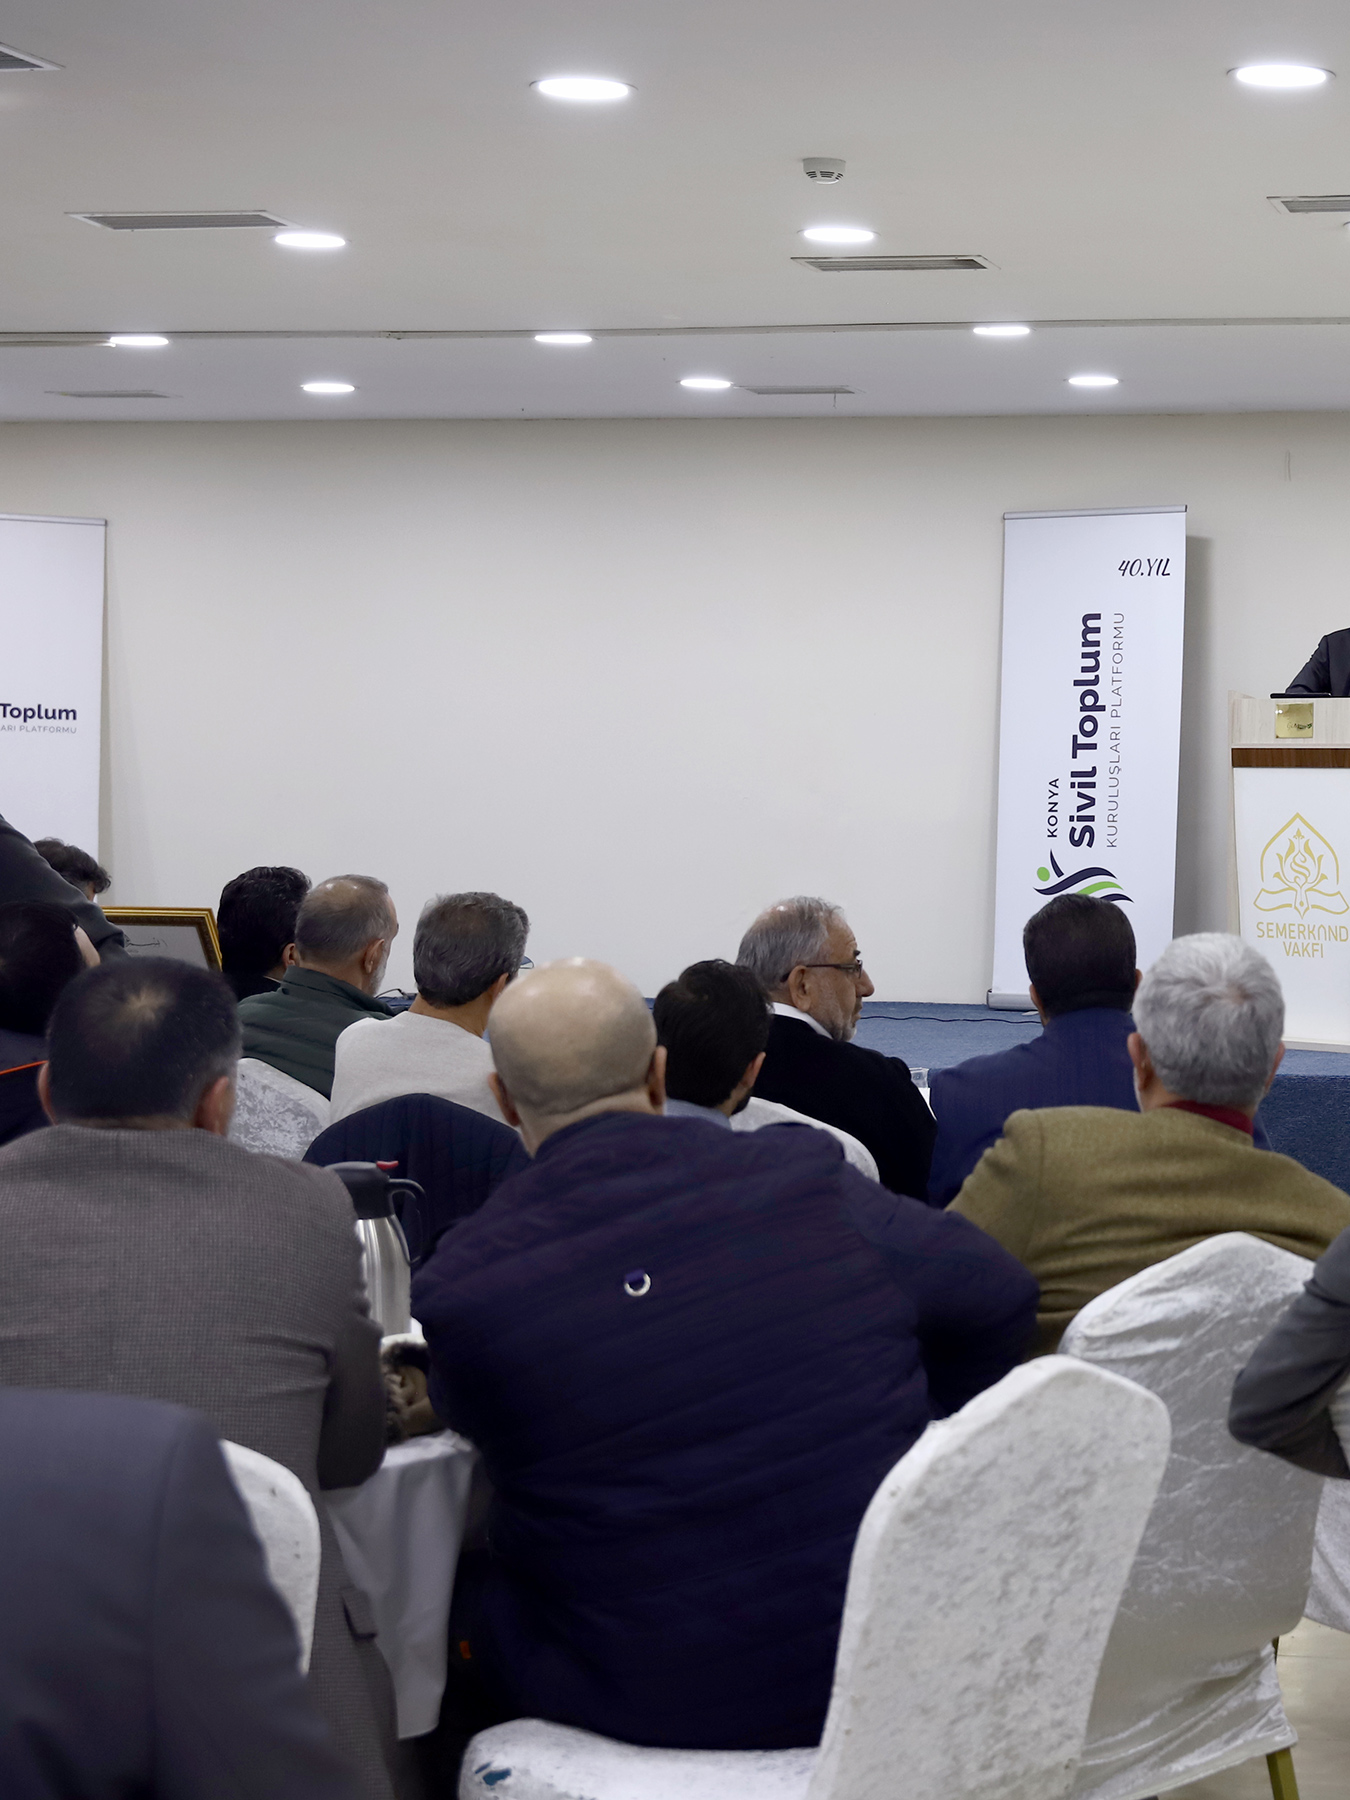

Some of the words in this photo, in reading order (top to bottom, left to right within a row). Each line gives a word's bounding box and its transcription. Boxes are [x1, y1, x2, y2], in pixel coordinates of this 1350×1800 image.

[1118, 558, 1171, 577] 40.YIL
[1071, 612, 1106, 759] Toplum
[1110, 612, 1125, 718] PLATFORMU
[0, 703, 77, 723] Toplum
[19, 725, 77, 734] PLATFORMU
[1047, 778, 1060, 838] KONYA
[1069, 766, 1098, 849] Sivil
[1106, 725, 1122, 848] KURULUŞLARI
[1283, 941, 1324, 958] VAKFI
